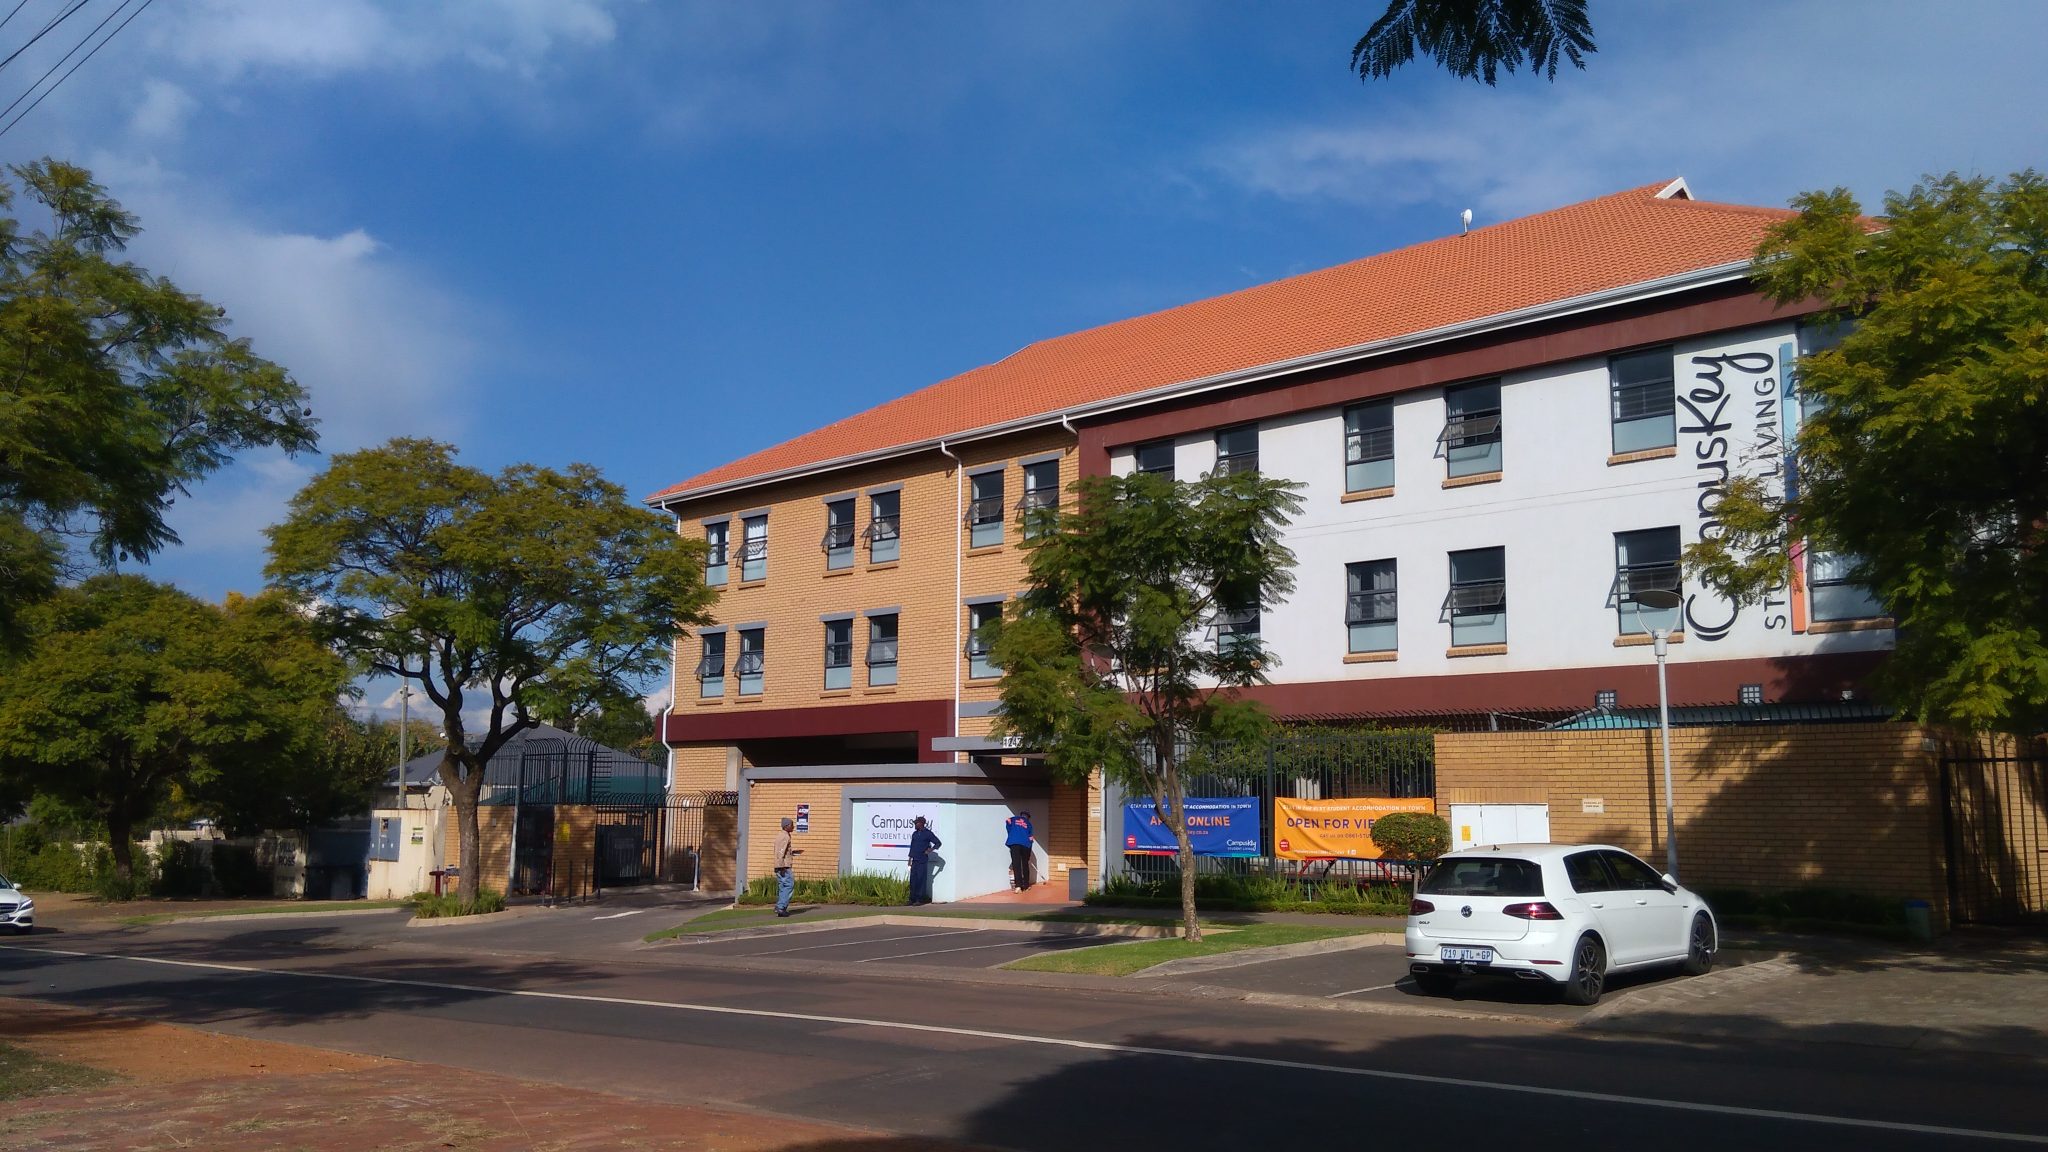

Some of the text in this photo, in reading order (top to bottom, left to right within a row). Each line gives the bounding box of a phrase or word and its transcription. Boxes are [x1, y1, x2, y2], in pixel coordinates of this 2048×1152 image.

[1754, 377, 1780, 478] LIVING
[871, 814, 933, 831] Campusy
[1187, 816, 1231, 827] ONLINE
[1287, 817, 1320, 829] OPEN
[1324, 818, 1350, 829] FOR
[871, 832, 912, 840] STUDENT LIV
[1443, 949, 1457, 959] 719
[1481, 950, 1491, 960] GP
